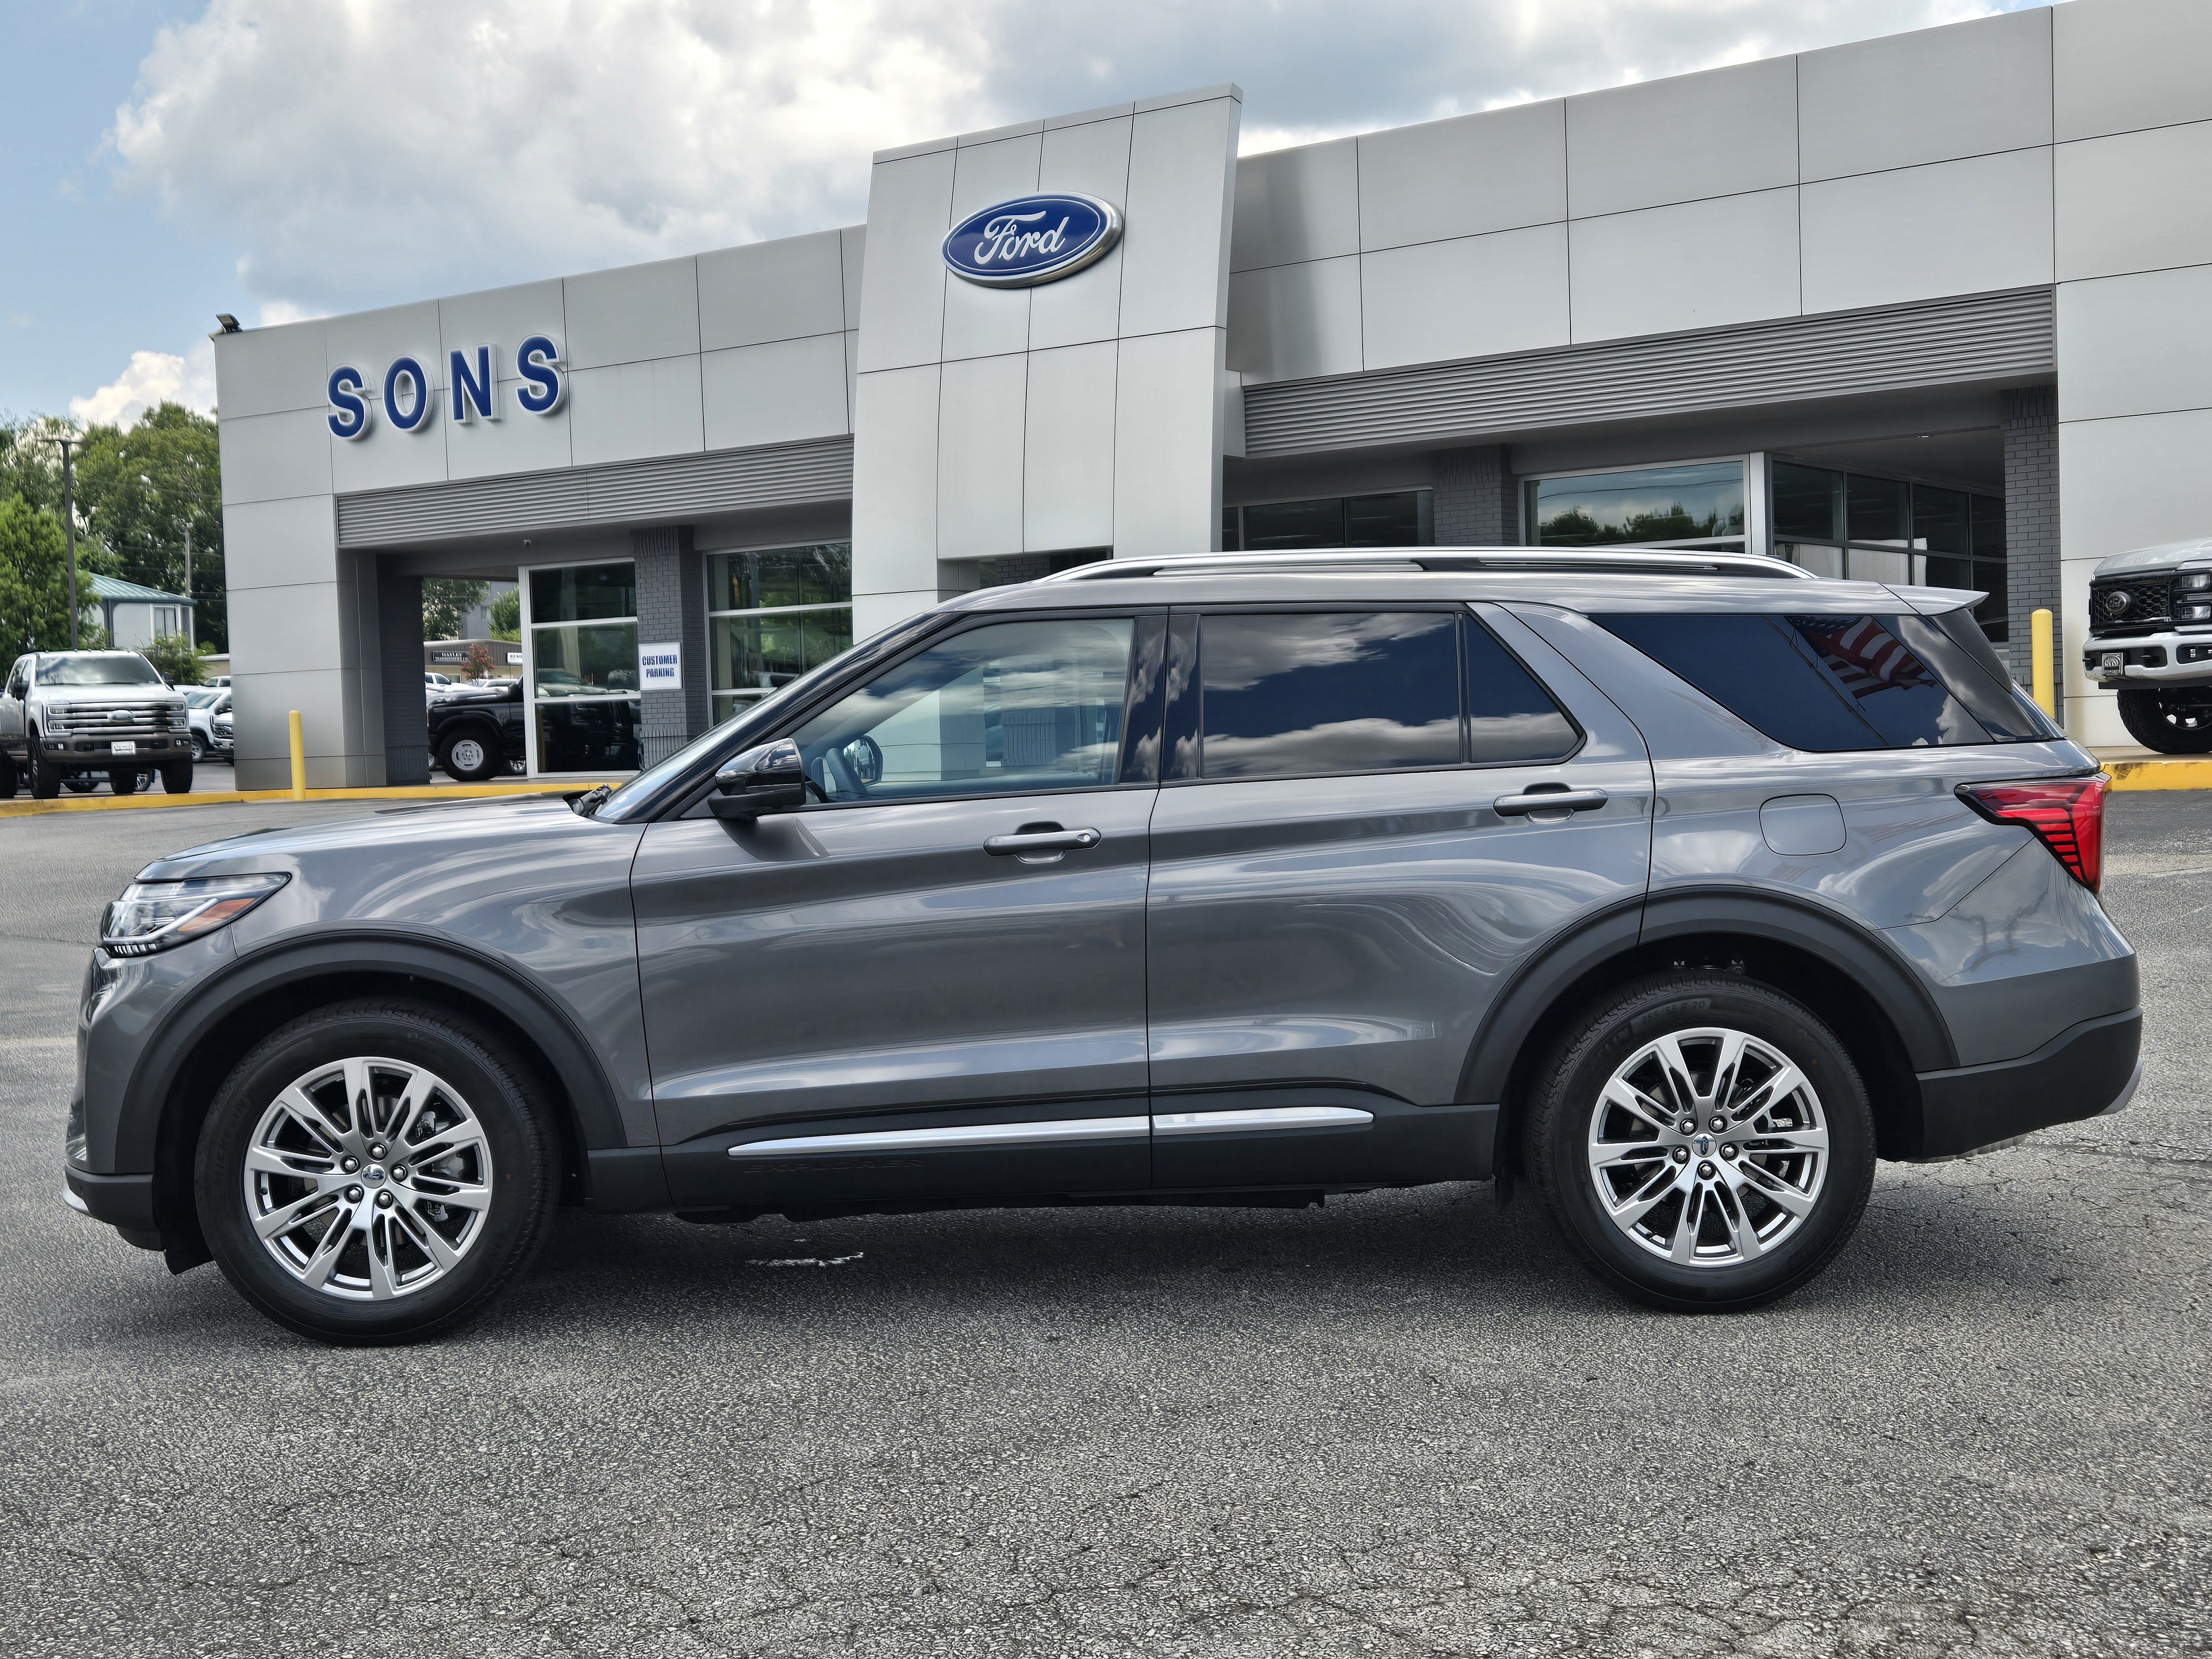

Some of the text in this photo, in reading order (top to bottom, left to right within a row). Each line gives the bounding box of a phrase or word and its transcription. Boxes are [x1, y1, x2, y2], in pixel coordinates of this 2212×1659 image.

[974, 211, 1070, 264] Ford
[327, 333, 566, 441] SONS
[642, 655, 677, 666] CUSTOMER
[646, 667, 674, 678] PARKING
